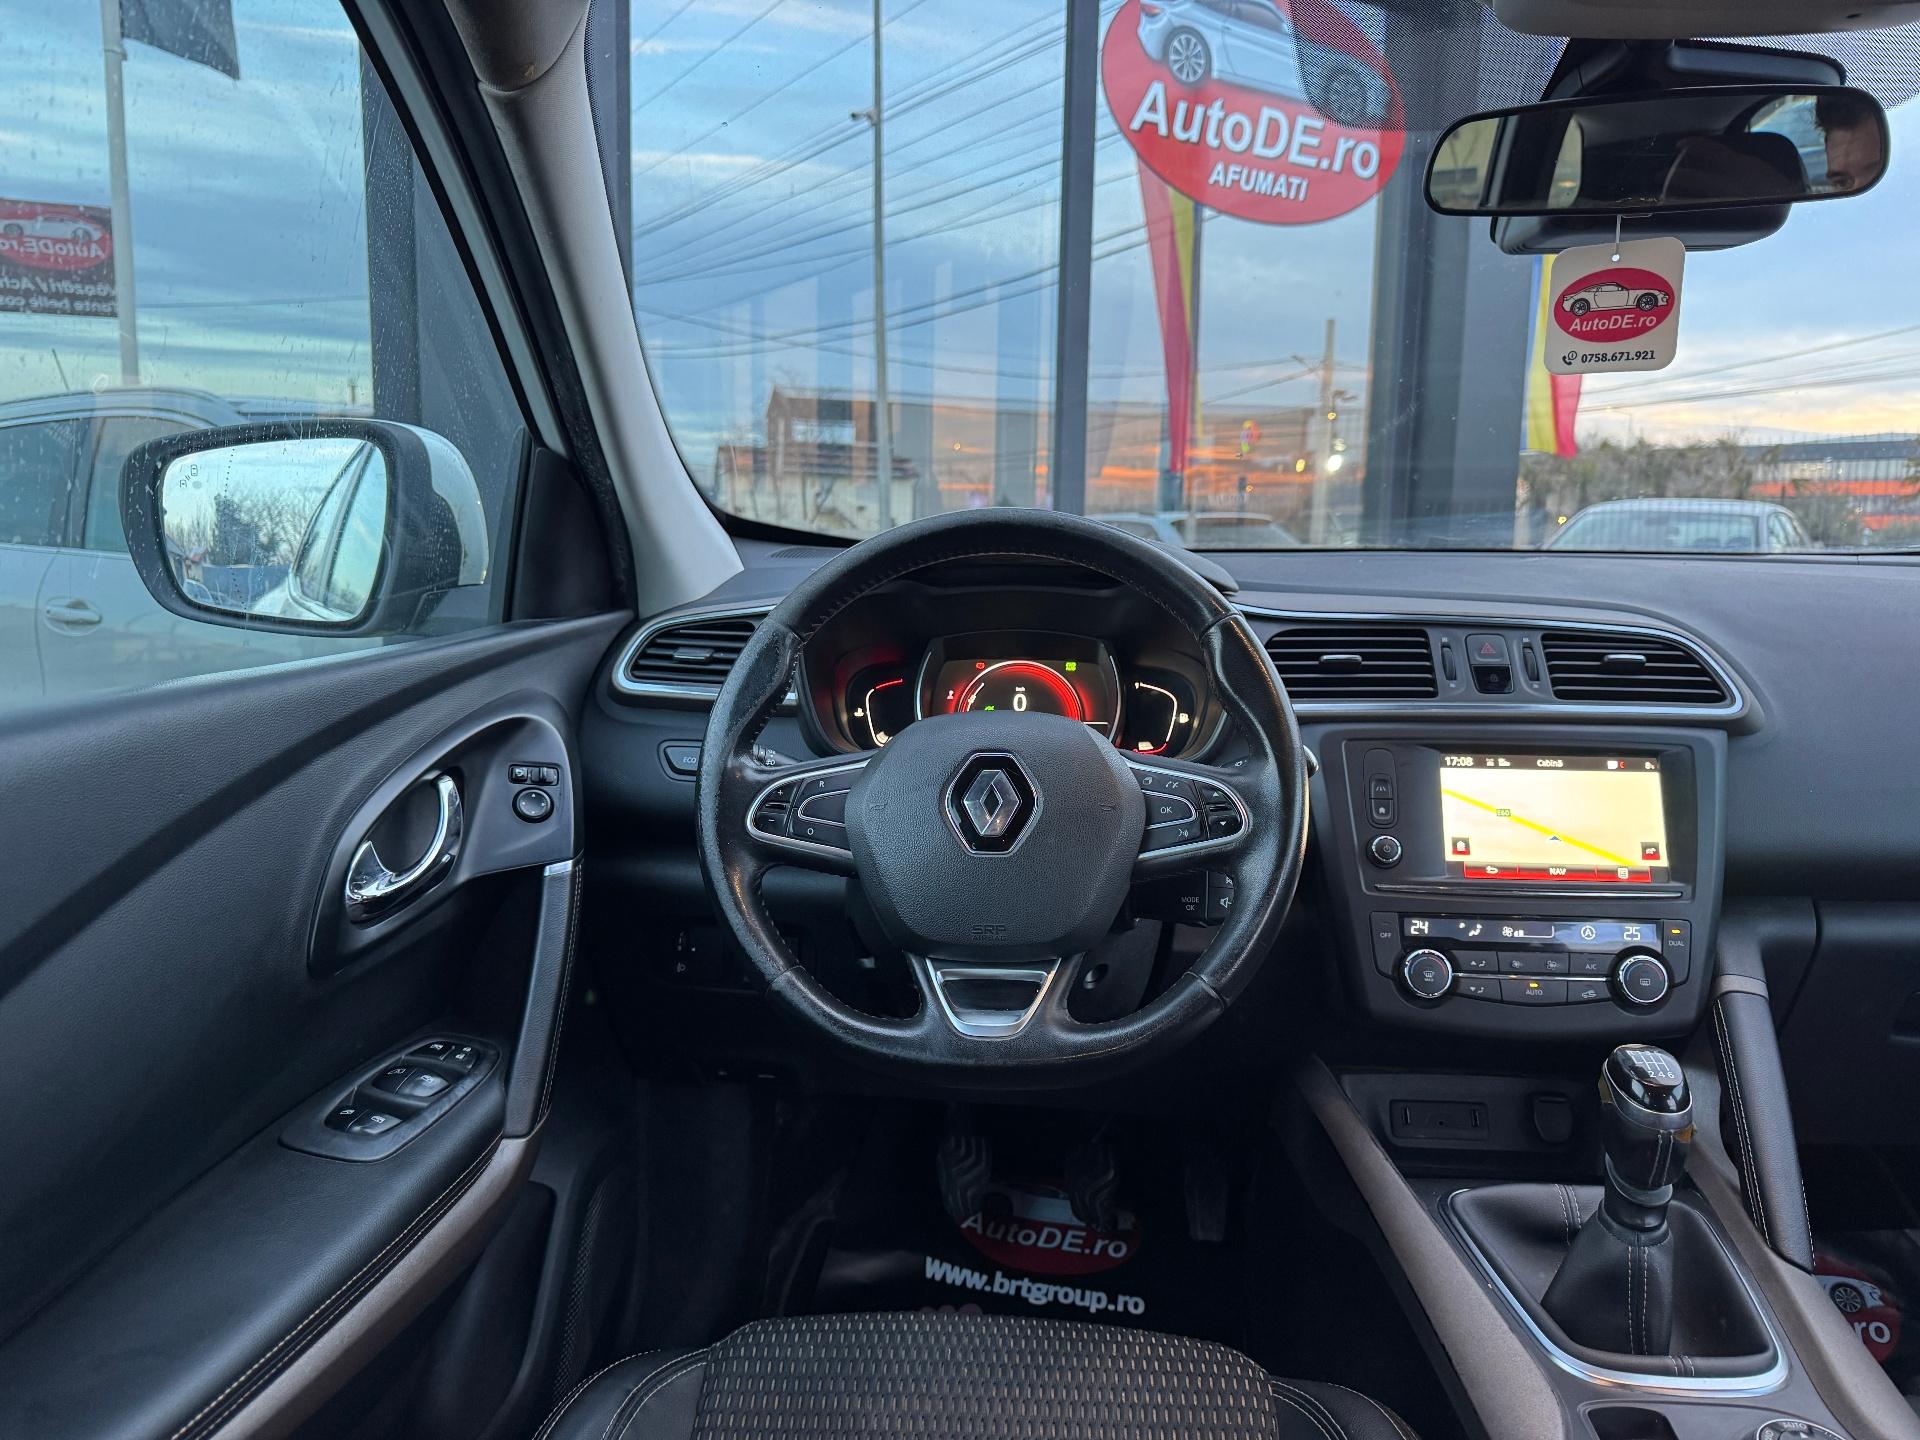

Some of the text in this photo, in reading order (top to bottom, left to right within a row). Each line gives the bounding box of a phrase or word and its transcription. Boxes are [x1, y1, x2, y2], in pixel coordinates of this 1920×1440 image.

[1130, 79, 1380, 179] AutoDE.ro
[1208, 160, 1308, 202] AFUMATI
[1569, 314, 1657, 332] AutoDE.ro
[1581, 350, 1656, 364] 0758.671.921
[1444, 755, 1474, 767] 17:08
[819, 780, 825, 788] R
[1160, 806, 1173, 814] OK
[1549, 867, 1567, 876] NAV
[971, 924, 1006, 934] SRP
[1410, 920, 1429, 935] 24
[1623, 926, 1641, 941] 25
[1668, 939, 1685, 947] DUAL
[1525, 988, 1543, 997] AUTO
[960, 1212, 1129, 1259] AutoDE.ro
[924, 1256, 1145, 1315] www.brtgroup.ro
